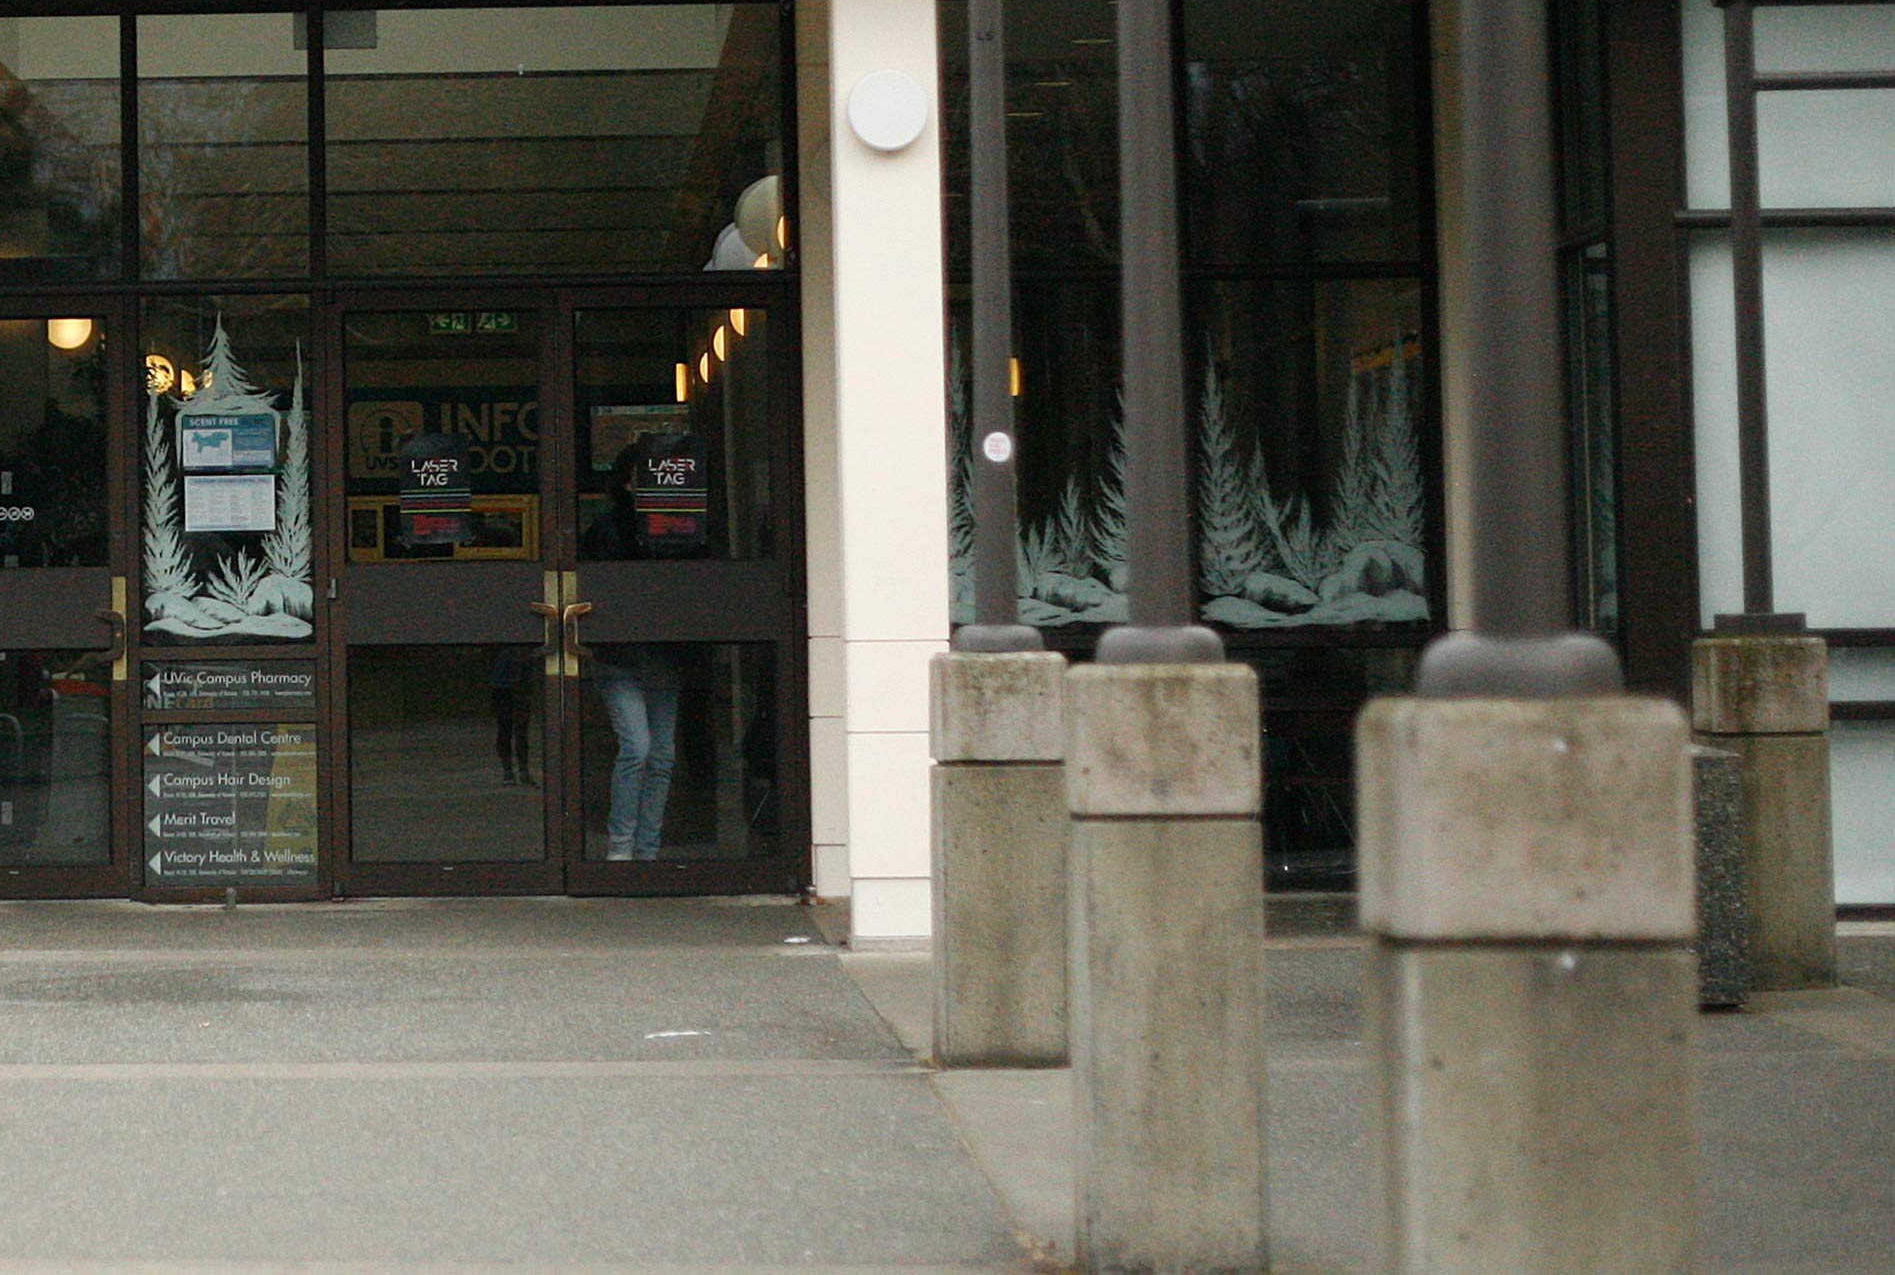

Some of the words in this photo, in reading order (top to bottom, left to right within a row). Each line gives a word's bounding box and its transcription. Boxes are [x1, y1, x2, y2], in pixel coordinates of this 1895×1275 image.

[189, 416, 216, 426] SCENT
[219, 416, 239, 426] FREE
[411, 458, 458, 473] LASER
[648, 458, 695, 472] LASER
[417, 473, 449, 486] TAG
[654, 473, 686, 485] TAG
[164, 671, 193, 685] UVic
[197, 671, 247, 687] Campus
[251, 669, 312, 687] Pharmacy
[163, 731, 214, 747] Campus
[217, 730, 257, 745] Dental
[260, 731, 302, 745] Centre
[163, 773, 214, 789] Campus
[218, 772, 245, 786] Hair
[249, 773, 291, 789] Design
[164, 812, 196, 825] Merit
[200, 811, 236, 825] Travel
[164, 850, 206, 866] Victory
[209, 848, 247, 863] Health
[250, 850, 261, 863] &
[264, 847, 315, 864] Wellness
